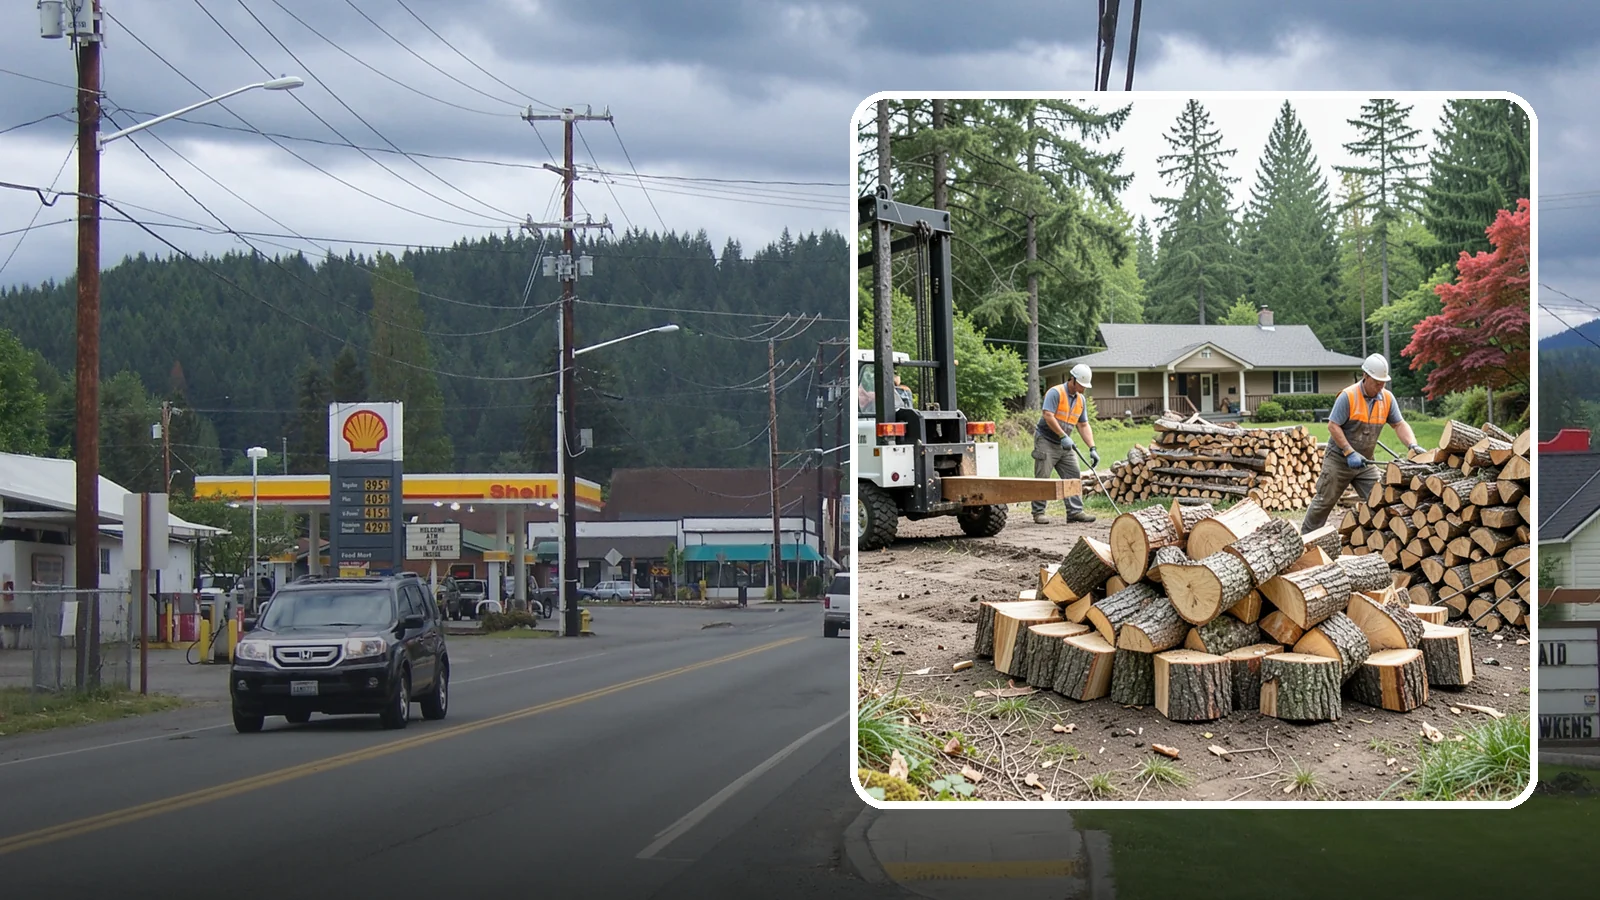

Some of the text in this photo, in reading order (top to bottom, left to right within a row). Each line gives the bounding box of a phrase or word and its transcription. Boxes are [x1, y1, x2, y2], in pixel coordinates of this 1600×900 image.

[366, 480, 383, 490] 395
[490, 484, 548, 499] Shell
[366, 494, 383, 504] 405
[366, 508, 383, 518] 415
[366, 522, 383, 533] 429
[1538, 643, 1567, 666] AID
